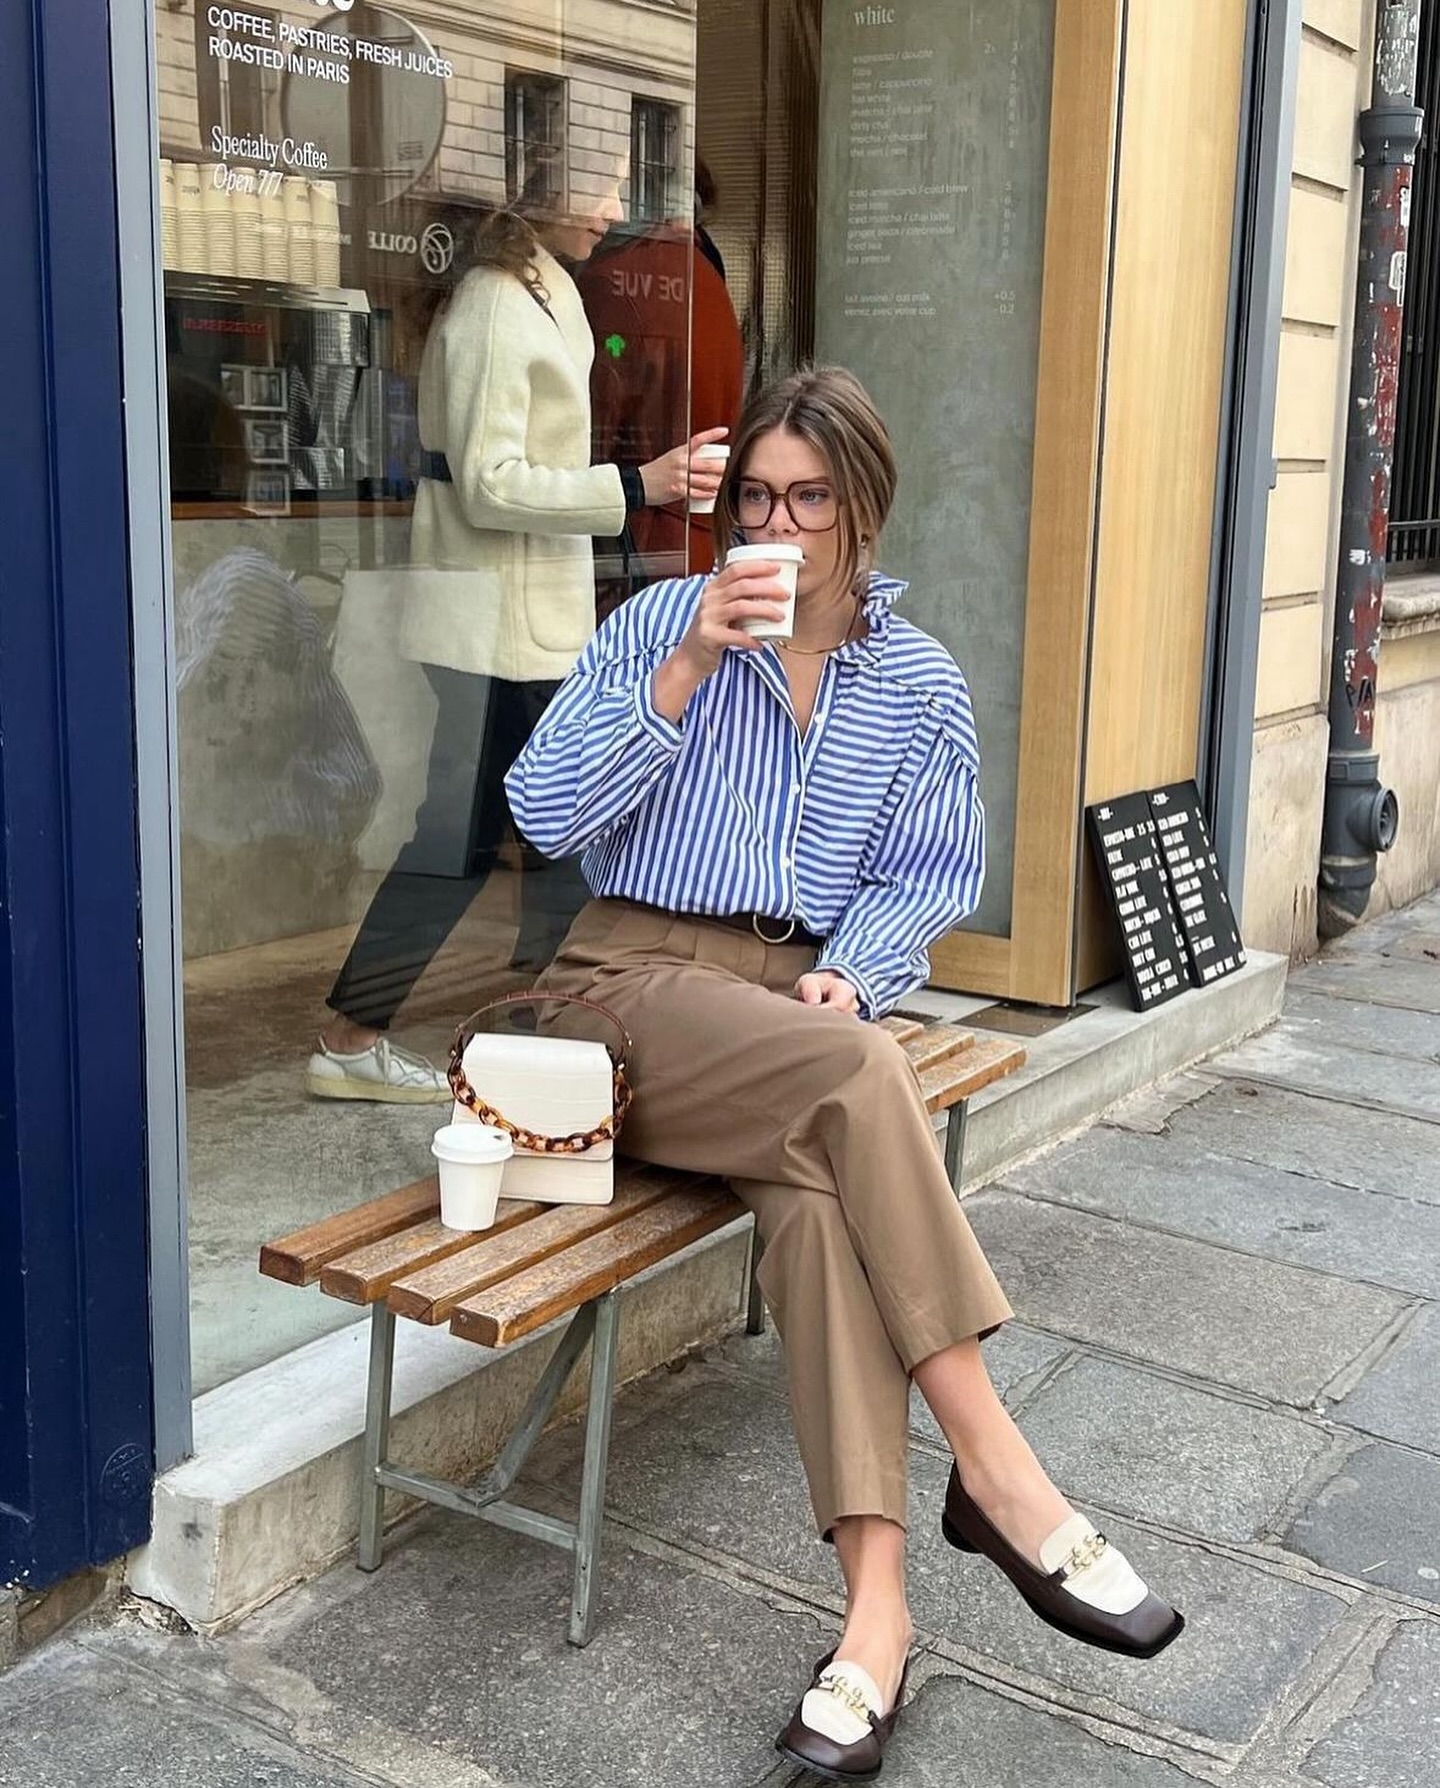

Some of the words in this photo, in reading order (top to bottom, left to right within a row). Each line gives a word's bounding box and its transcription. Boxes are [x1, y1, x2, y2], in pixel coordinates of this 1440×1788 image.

[854, 5, 895, 26] white
[207, 6, 275, 43] COFFEE,
[279, 22, 353, 60] PASTRIES,
[355, 39, 402, 68] FRESH
[404, 51, 453, 79] JUICES
[208, 36, 284, 70] ROASTED
[287, 53, 304, 74] IN
[307, 57, 350, 84] PARIS
[211, 125, 279, 168] Specialty
[281, 138, 328, 170] Coffee
[213, 162, 257, 197] Open
